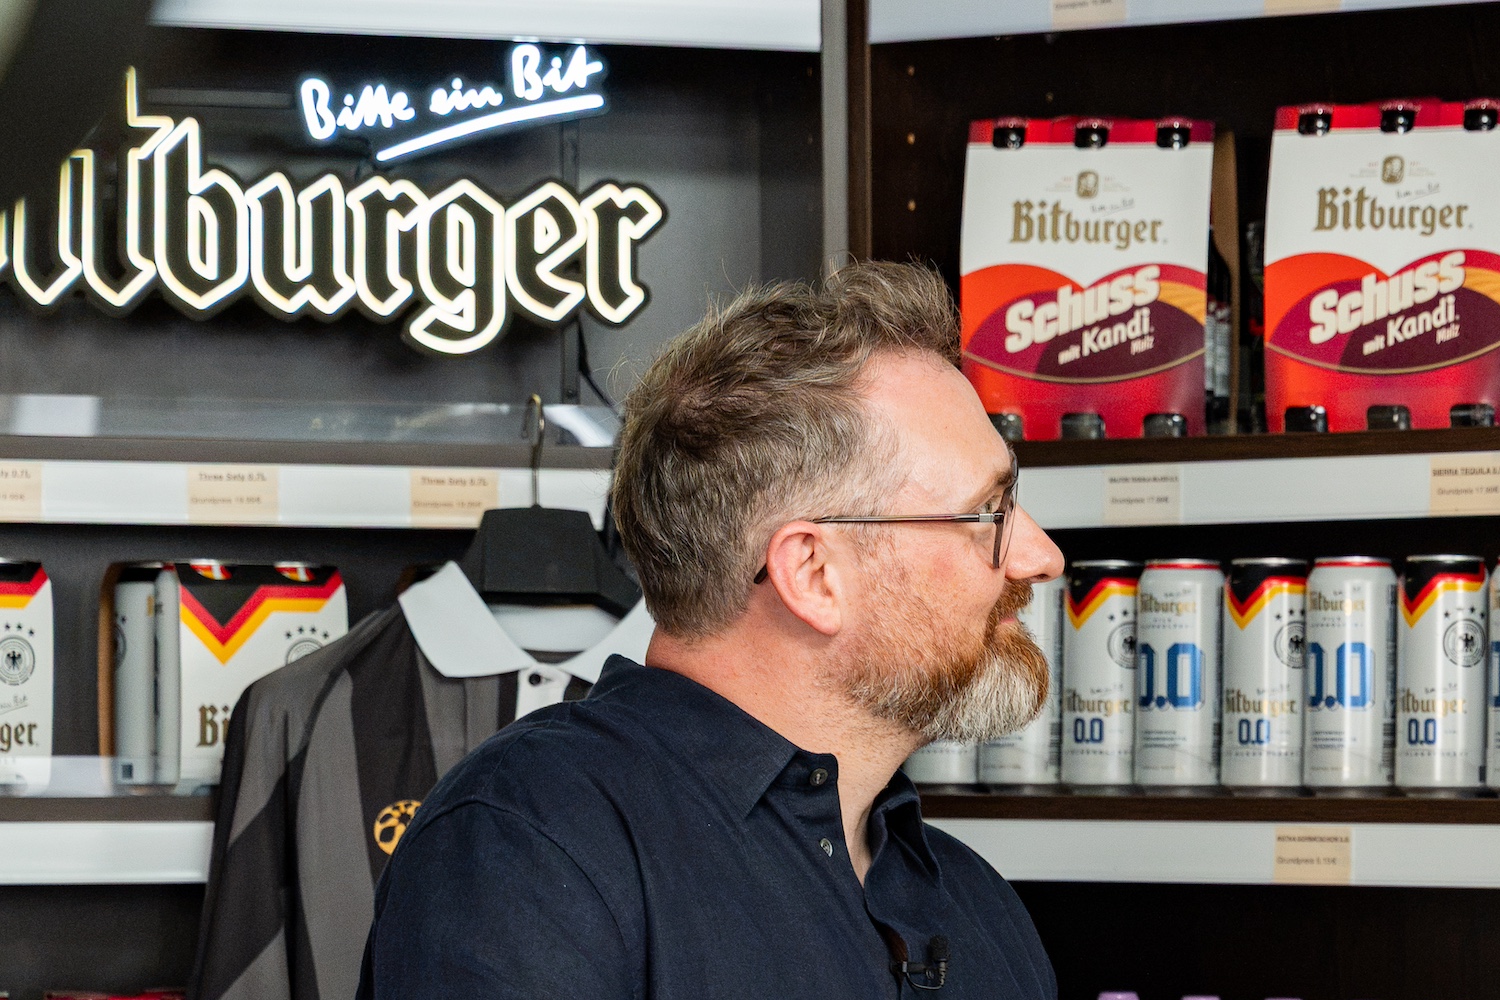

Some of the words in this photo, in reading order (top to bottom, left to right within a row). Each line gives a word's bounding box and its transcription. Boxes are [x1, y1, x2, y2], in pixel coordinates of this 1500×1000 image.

[301, 78, 415, 140] Bitte
[429, 77, 503, 115] ein
[512, 44, 603, 101] Bit
[0, 63, 661, 354] itburger
[1010, 200, 1163, 250] Bitburger
[1314, 186, 1469, 237] Bitburger
[1004, 265, 1160, 353] Schuss
[1309, 250, 1466, 344] Schuss
[1058, 345, 1080, 365] mit
[1082, 306, 1151, 357] Kandi
[1362, 335, 1385, 356] mit
[1386, 294, 1456, 347] Kandi
[1400, 688, 1467, 718] itburger
[1074, 718, 1104, 744] 0.0
[1238, 718, 1270, 745] 0.0
[1408, 718, 1438, 745] 0.0
